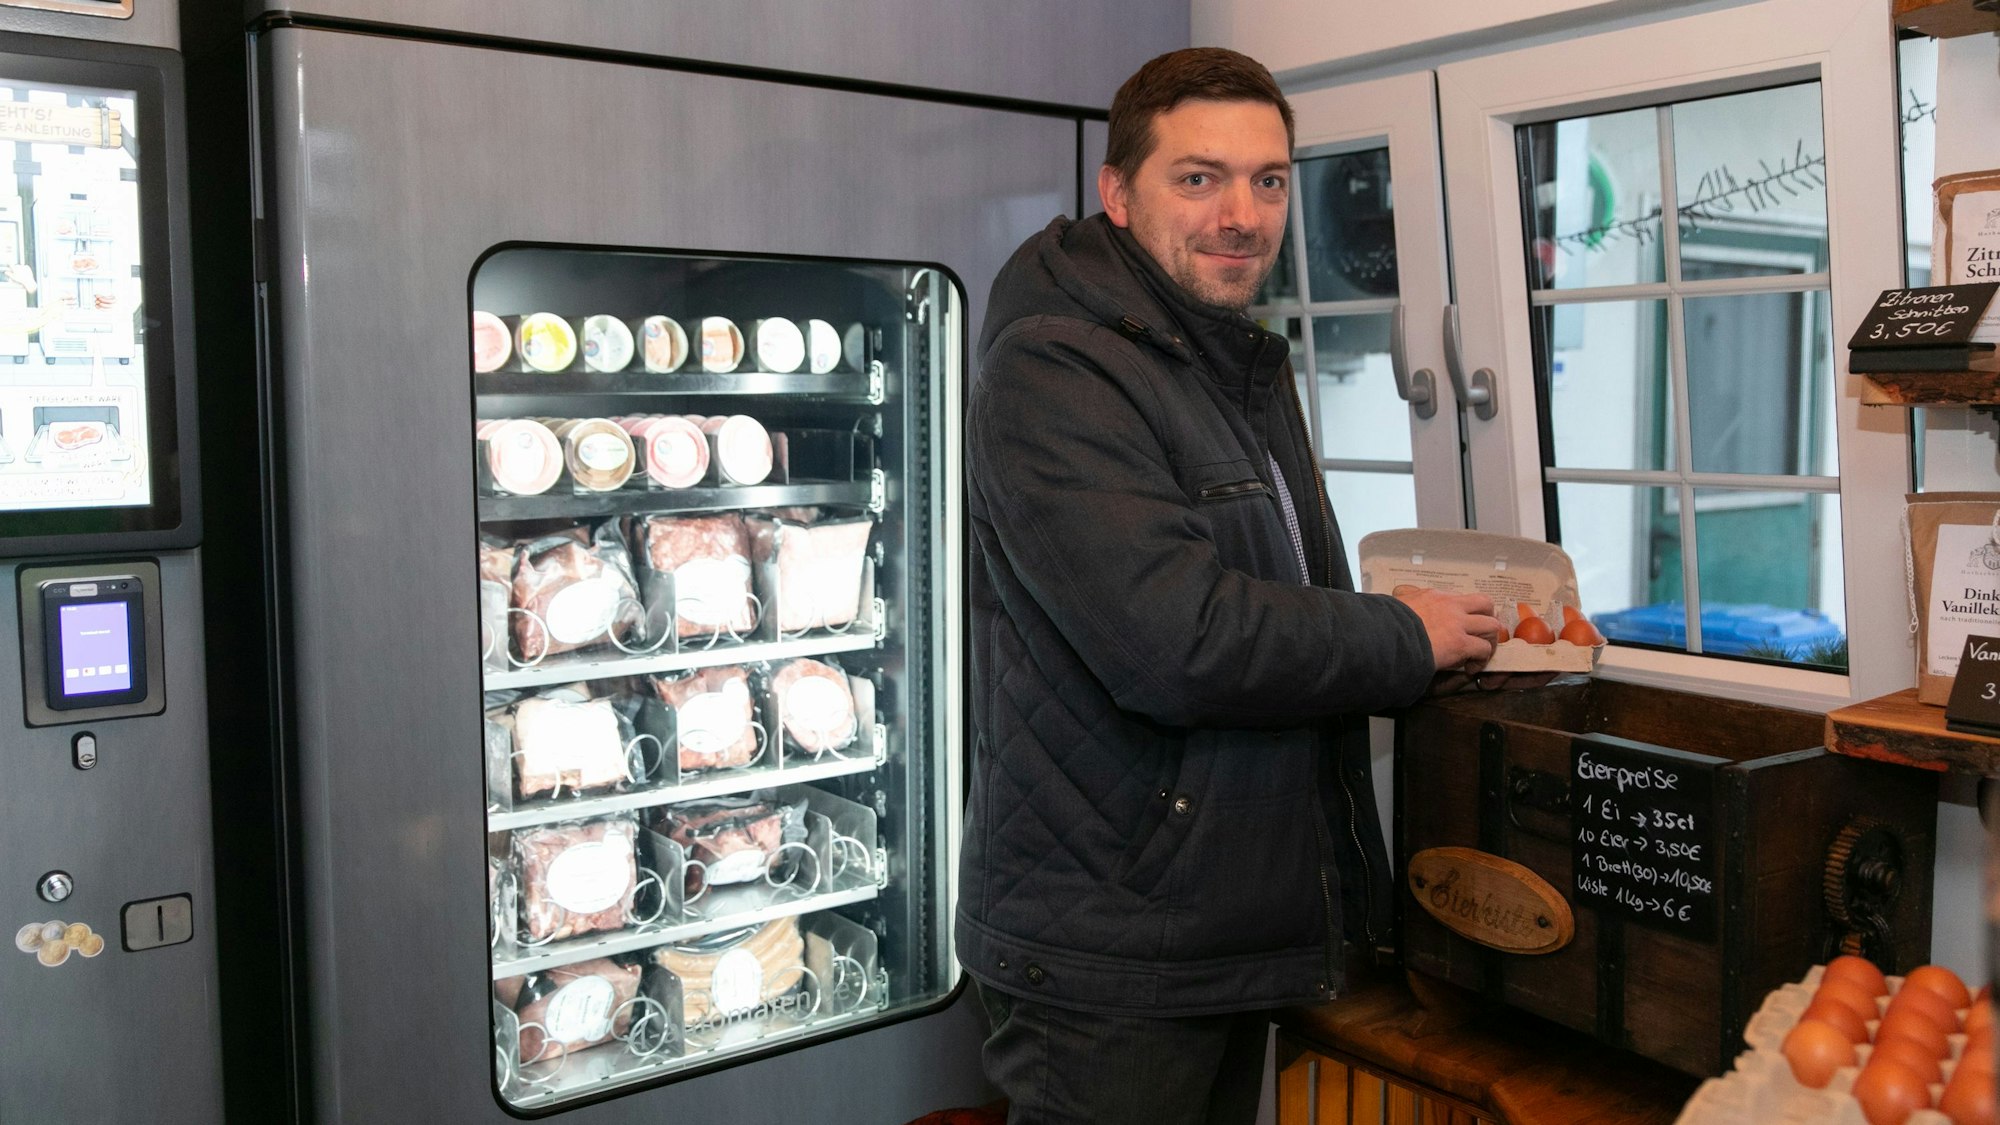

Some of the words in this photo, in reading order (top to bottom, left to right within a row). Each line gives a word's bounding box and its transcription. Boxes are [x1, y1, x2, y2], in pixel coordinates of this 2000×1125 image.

[1966, 262, 2000, 278] Sch
[1879, 291, 1955, 308] Zitronen
[1887, 305, 1969, 321] Schnitten
[1869, 321, 1955, 340] 3,50€
[1578, 752, 1679, 793] Eierpreise
[1582, 794, 1592, 814] 1
[1601, 799, 1620, 821] Ei
[1652, 809, 1694, 830] 35ct
[1578, 827, 1595, 843] 10
[1600, 829, 1630, 848] Eier
[1655, 840, 1701, 861] 3,50€
[1582, 853, 1590, 868] 1
[1578, 874, 1608, 897] Kiste
